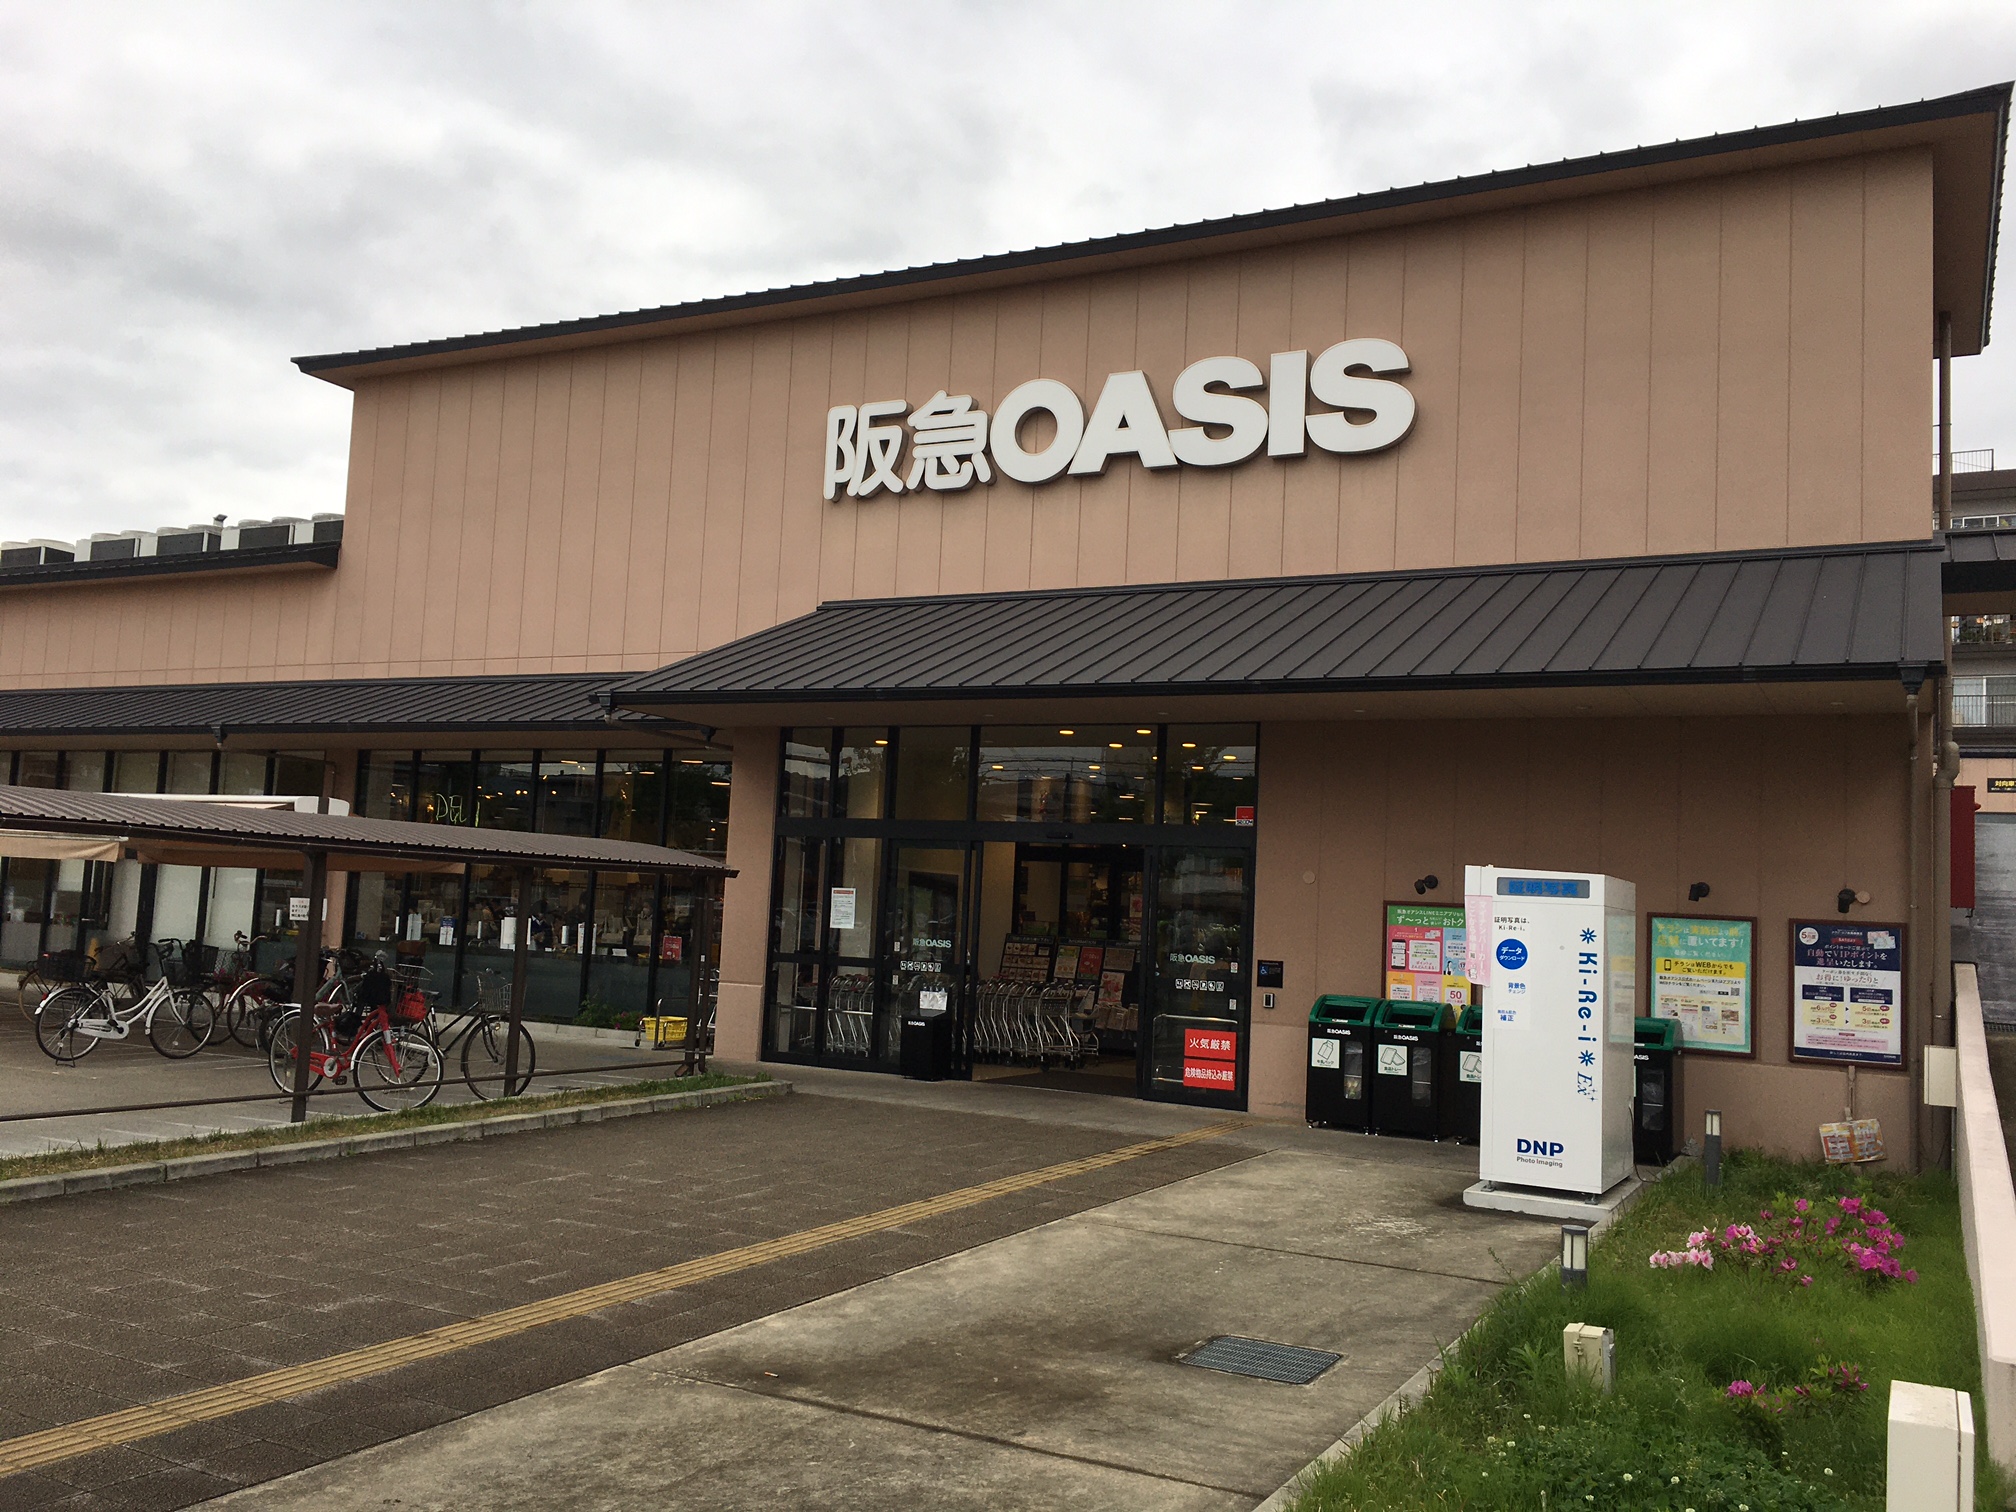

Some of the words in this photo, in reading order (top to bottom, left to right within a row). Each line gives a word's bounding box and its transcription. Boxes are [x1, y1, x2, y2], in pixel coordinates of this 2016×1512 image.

[823, 337, 1418, 502] 阪急OASIS
[1508, 879, 1579, 897] 証明写真
[1501, 946, 1523, 955] データ
[1449, 990, 1462, 1000] 50
[1578, 952, 1597, 1042] Ki-Re-i
[1189, 1037, 1231, 1051] 火気厳禁
[1517, 1138, 1564, 1157] DNP
[1517, 1156, 1536, 1165] Photo
[1536, 1158, 1563, 1168] Imaging
